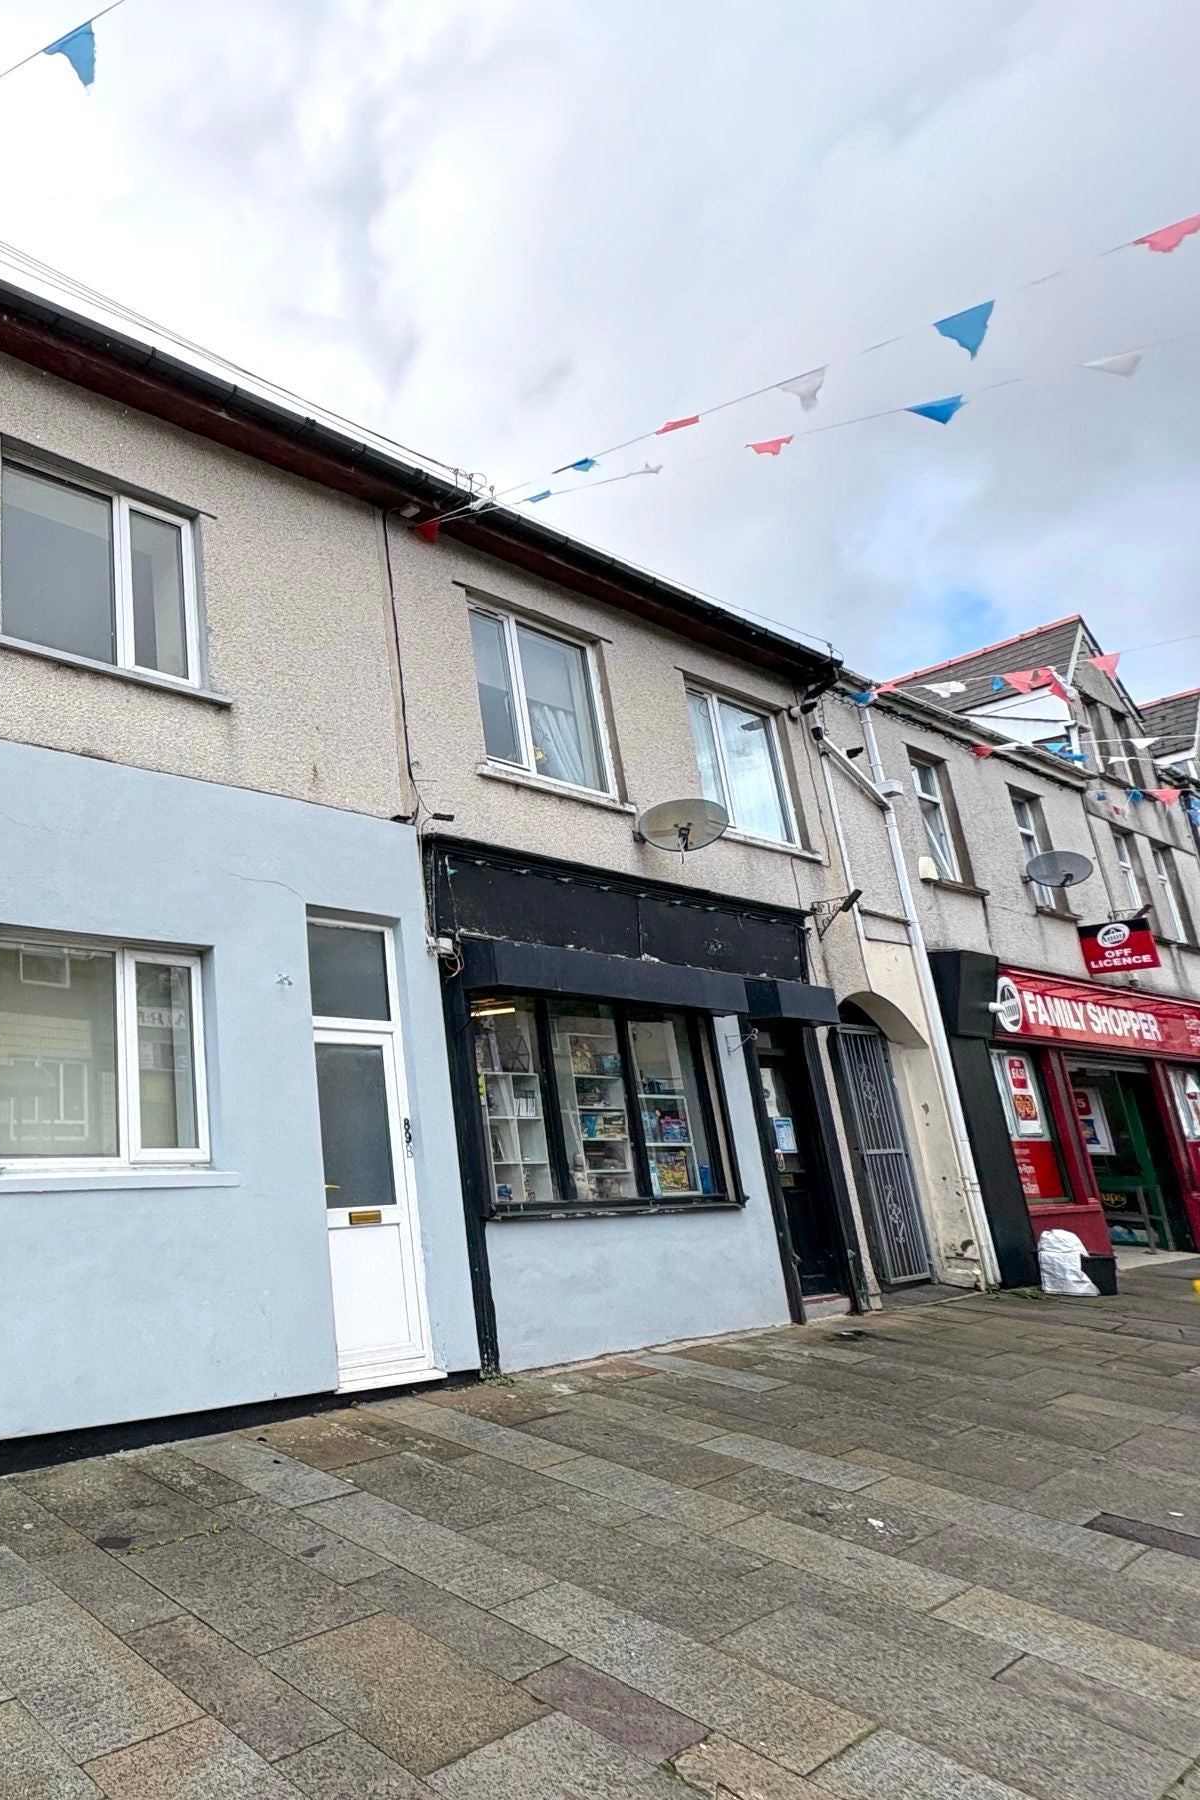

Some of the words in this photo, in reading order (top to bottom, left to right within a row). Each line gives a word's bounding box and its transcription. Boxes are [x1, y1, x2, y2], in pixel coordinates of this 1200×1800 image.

[1104, 947, 1132, 958] OFF
[1090, 954, 1153, 969] LICENCE
[1022, 991, 1087, 1032] FAMILY
[1086, 1001, 1162, 1042] SHOPPER
